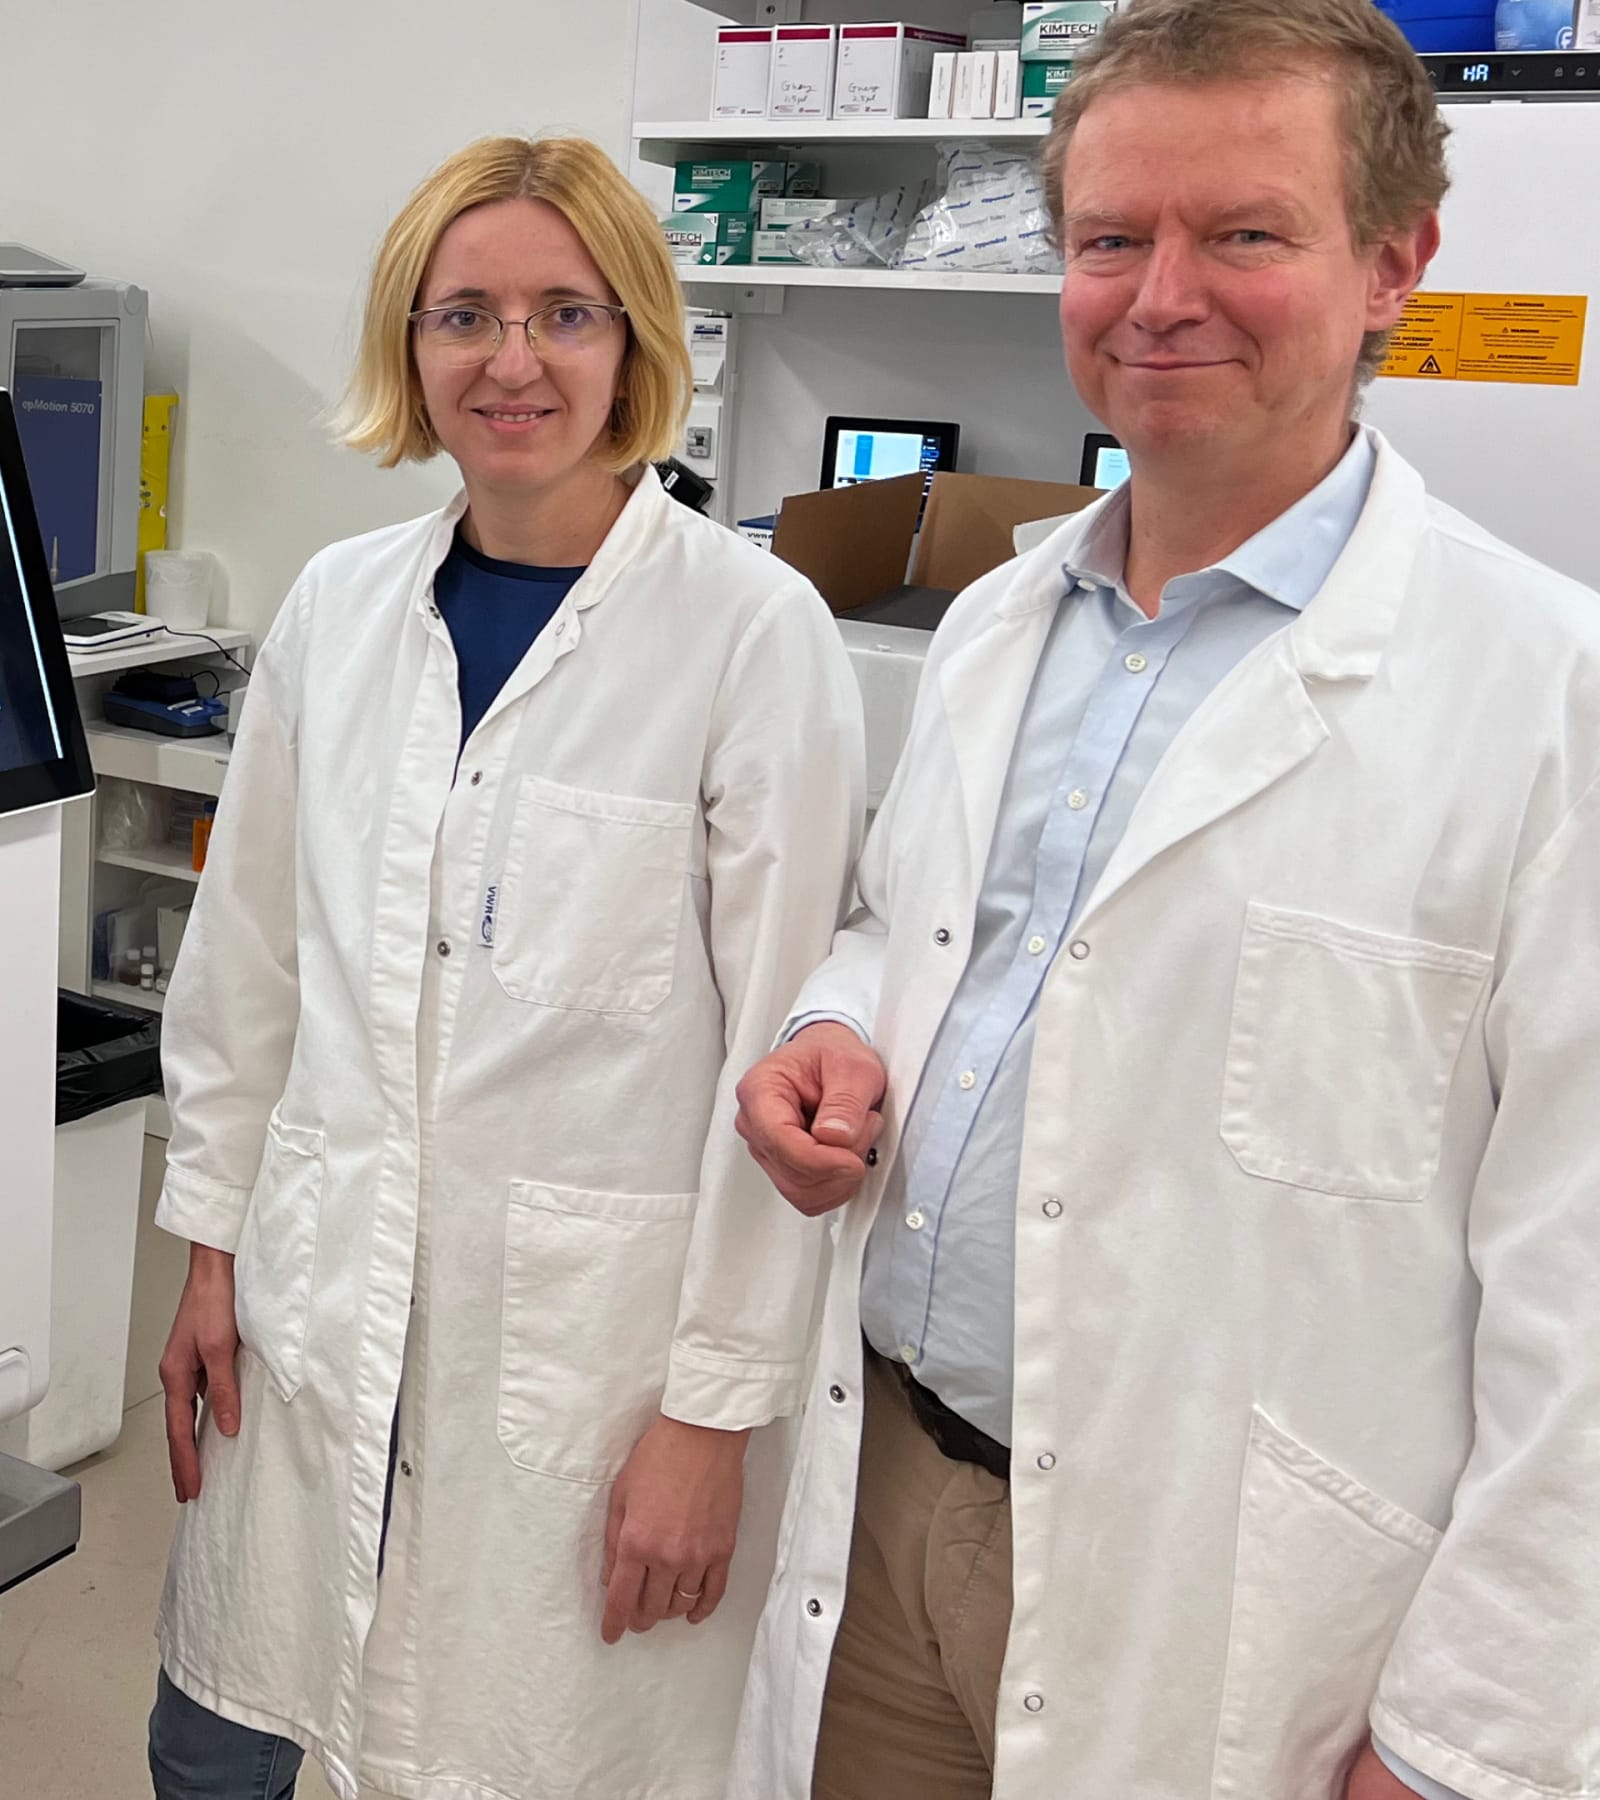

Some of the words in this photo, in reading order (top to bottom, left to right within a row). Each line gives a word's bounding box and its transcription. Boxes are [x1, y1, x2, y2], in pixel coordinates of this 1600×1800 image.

[1040, 23, 1098, 34] KIMTECH
[1046, 70, 1072, 79] KIMT
[664, 232, 702, 242] MTECH
[22, 399, 68, 412] epMotion
[70, 402, 95, 414] 5070
[484, 886, 497, 914] VWR
